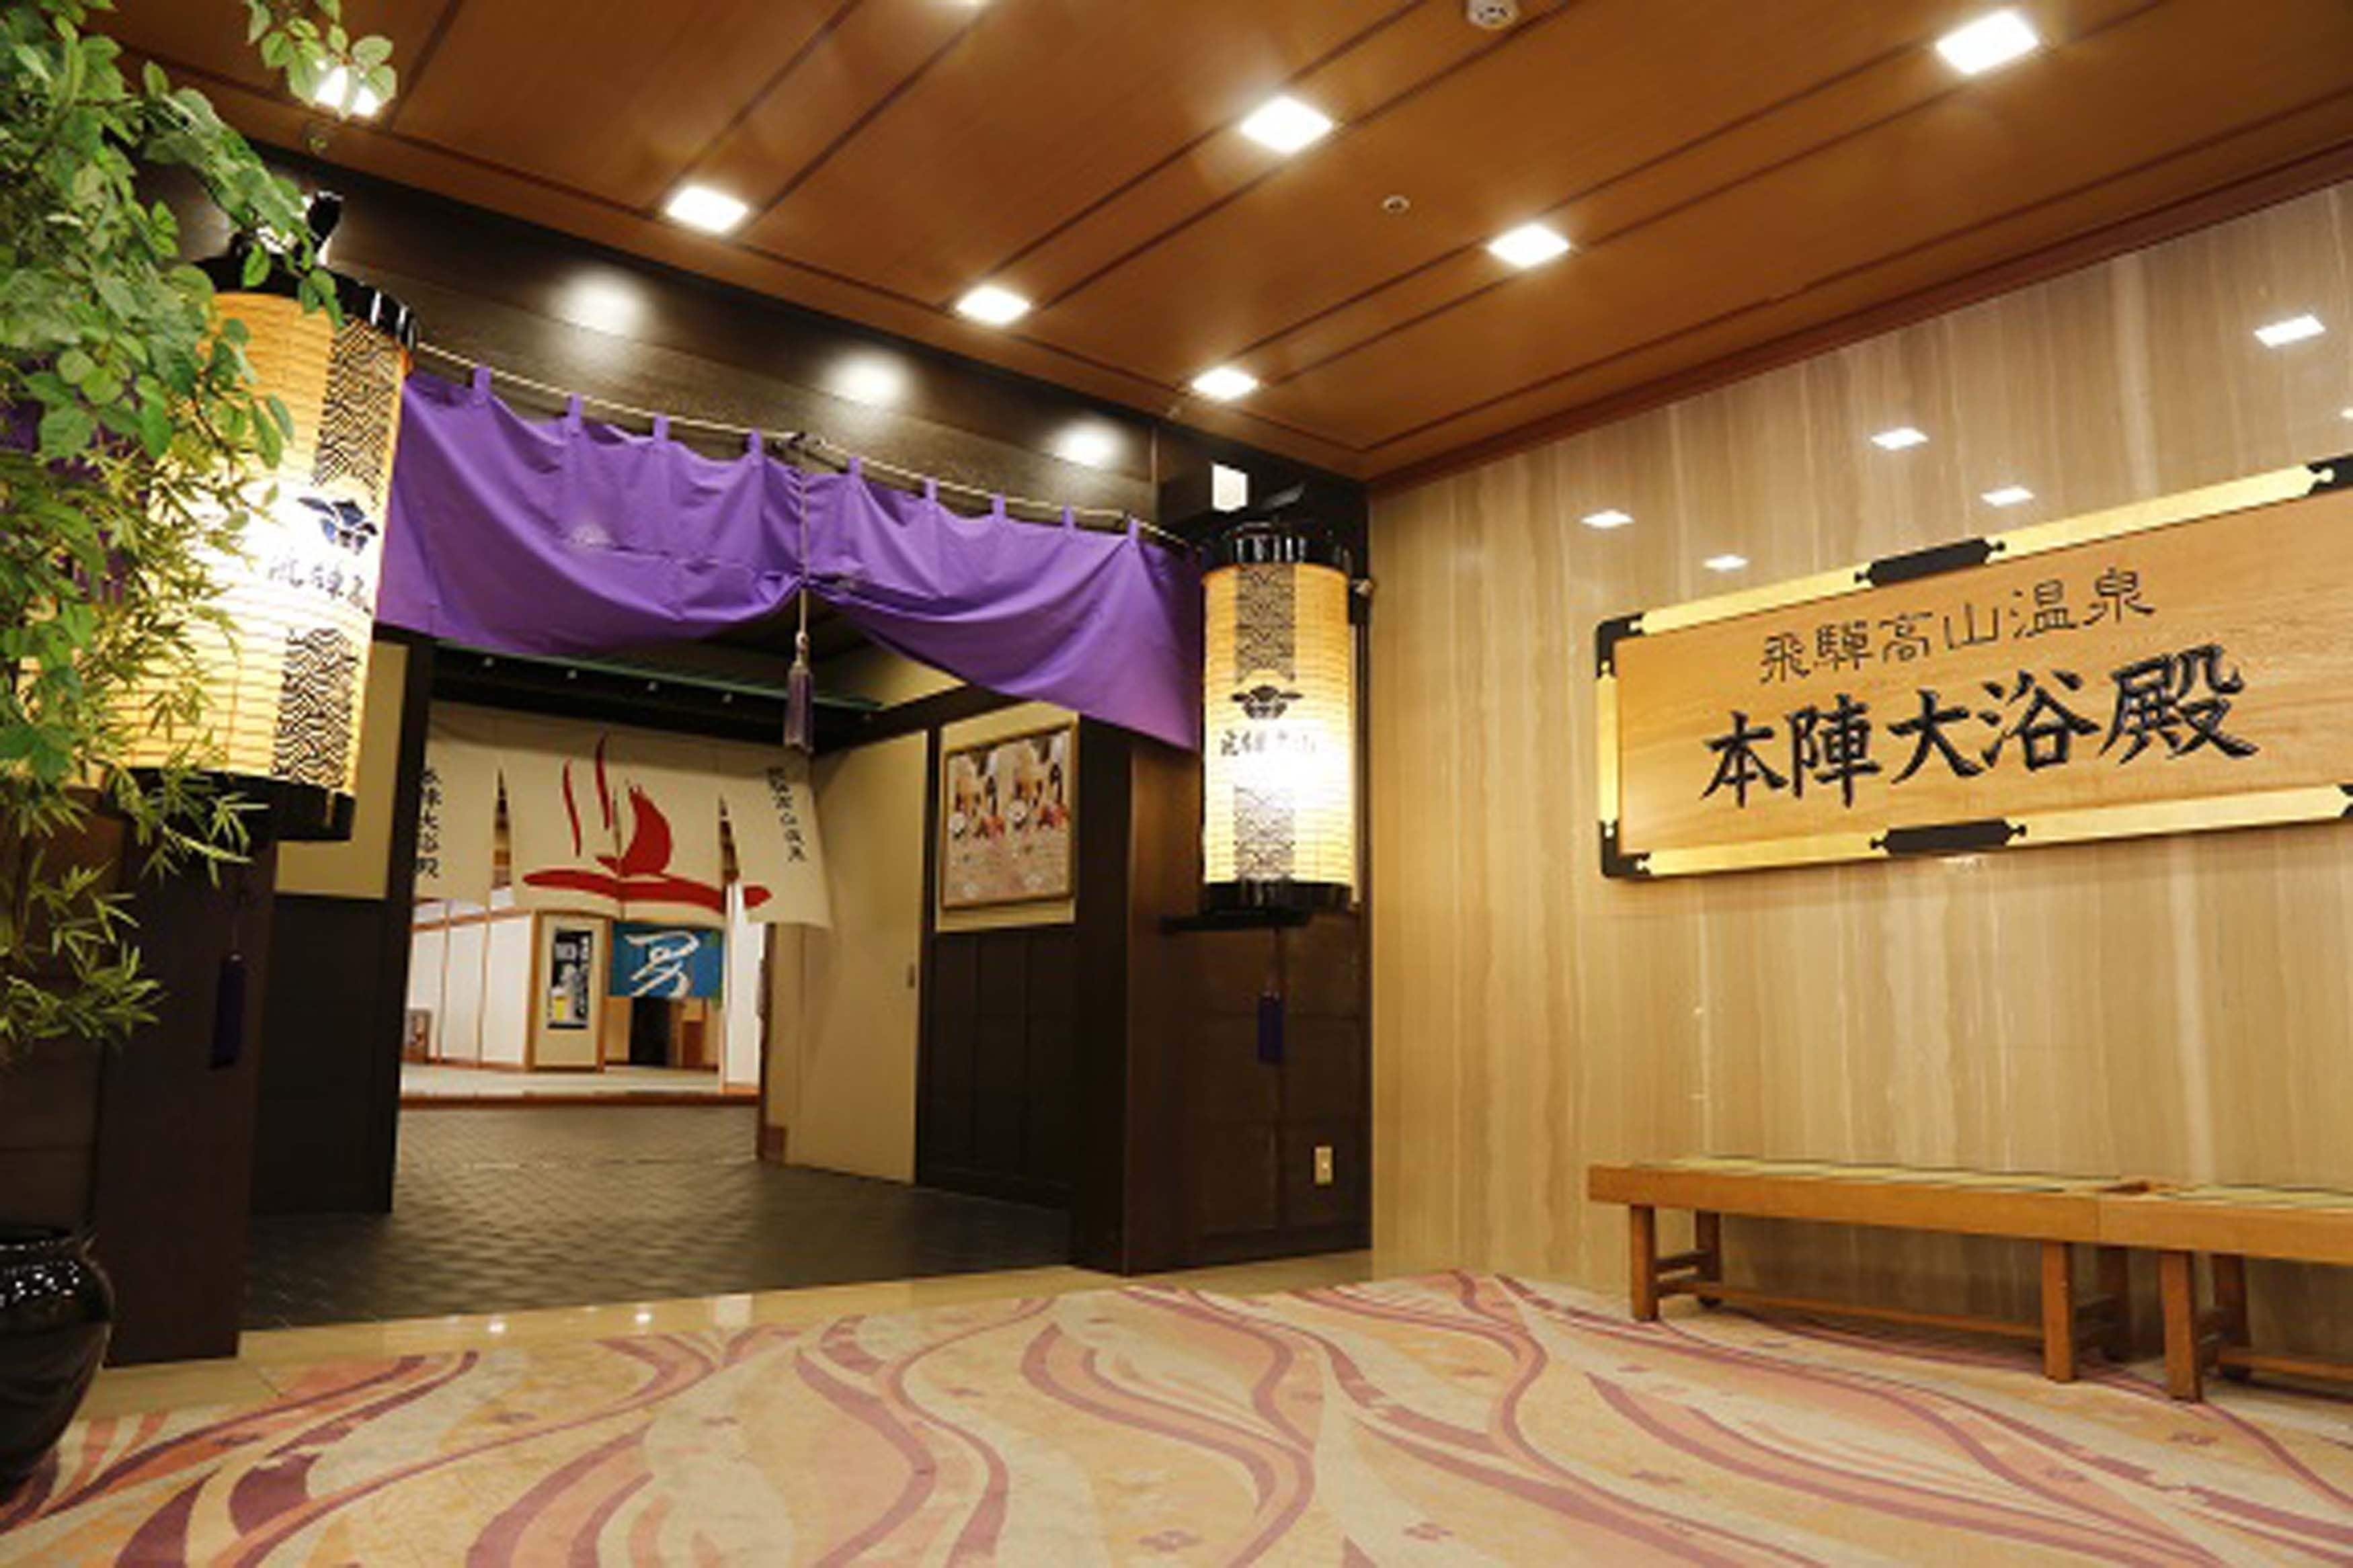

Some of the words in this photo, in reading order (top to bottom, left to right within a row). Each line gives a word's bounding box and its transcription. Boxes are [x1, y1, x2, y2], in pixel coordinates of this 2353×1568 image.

[1700, 643, 2260, 808] 本陣大浴殿
